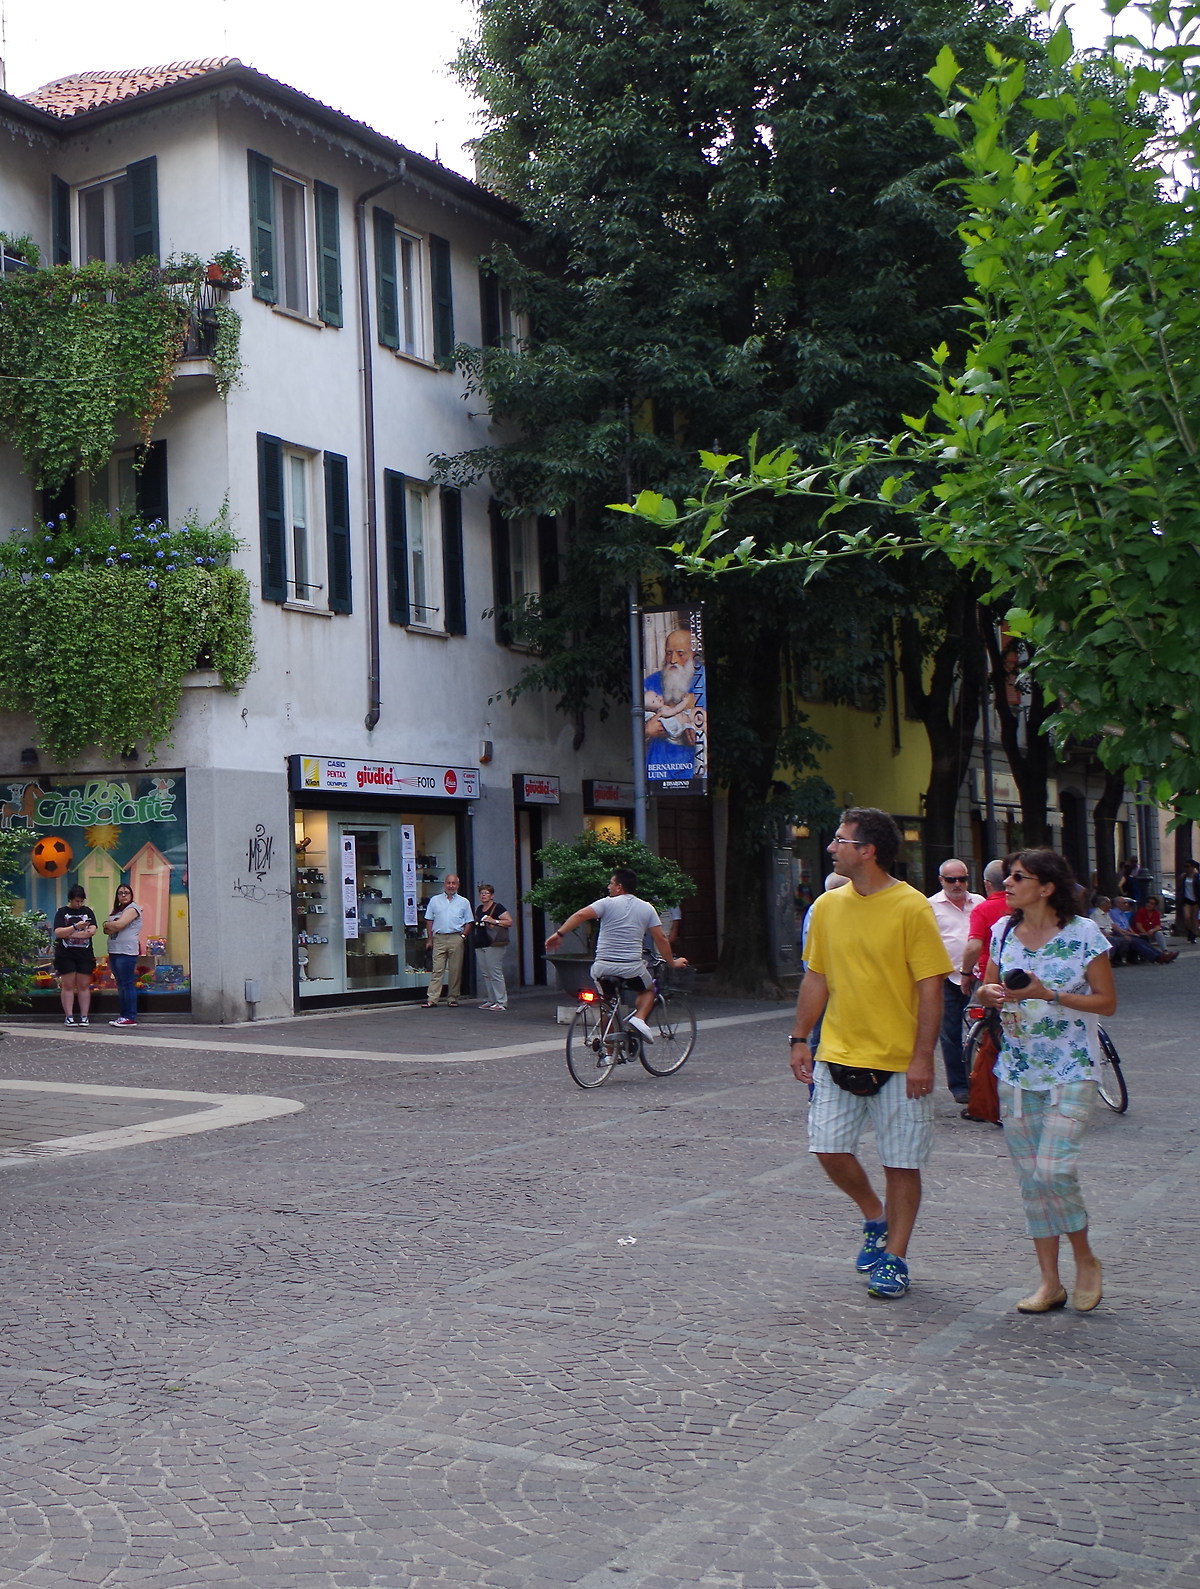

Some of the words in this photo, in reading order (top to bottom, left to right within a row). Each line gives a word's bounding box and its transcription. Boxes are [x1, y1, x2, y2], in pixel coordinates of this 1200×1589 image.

[693, 653, 705, 776] SARONNO
[327, 760, 346, 768] CASIO
[647, 762, 693, 771] BERNARDINO
[327, 770, 347, 779] PENTAX
[357, 765, 393, 788] giudici
[647, 771, 667, 779] LUINI
[326, 780, 348, 788] OLYMPUS
[417, 776, 436, 789] FOTO
[526, 780, 549, 796] giudici
